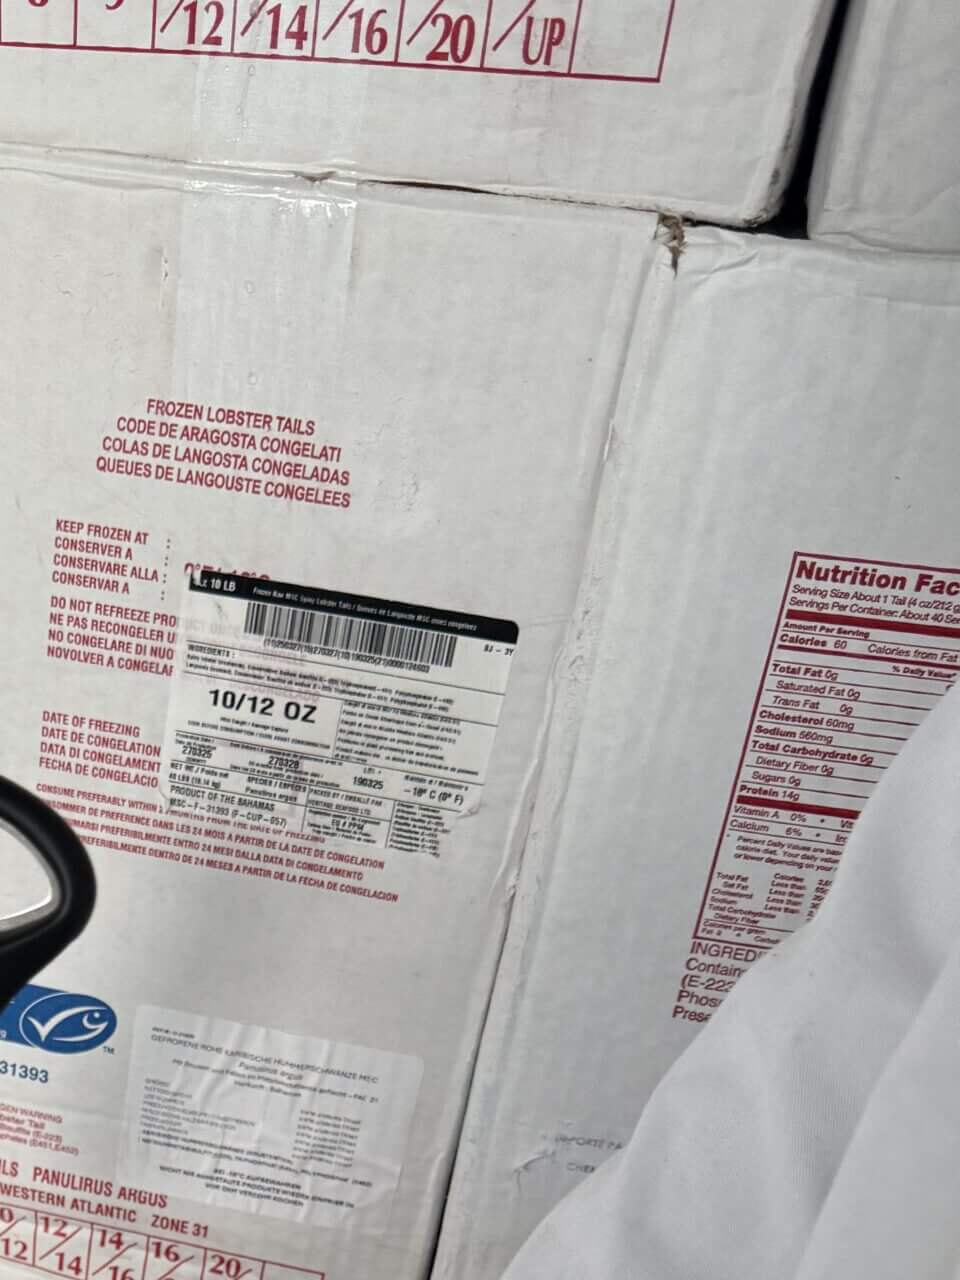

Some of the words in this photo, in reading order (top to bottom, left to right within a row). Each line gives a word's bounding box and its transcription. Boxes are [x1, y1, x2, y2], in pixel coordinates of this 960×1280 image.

[147, 399, 204, 420] FROZEN
[207, 407, 271, 429] LOBSTER
[277, 416, 315, 436] TAILS
[117, 417, 156, 435] CODE
[159, 422, 177, 437] DE
[181, 426, 257, 450] ARAGOSTA
[260, 437, 341, 462] CONGELATI
[102, 436, 149, 456] COLAS
[152, 442, 171, 459] DE
[175, 446, 247, 470] LANGOSTA
[251, 457, 349, 486] CONGELADAS
[96, 457, 152, 478] QUEUES
[155, 465, 174, 481] DE
[176, 469, 261, 494] LANGOUSTE
[264, 482, 350, 508] CONGELEES
[56, 519, 84, 534] KEEP
[88, 524, 131, 543] FROZEN
[135, 532, 149, 545] AT
[55, 536, 122, 558] CONSERVER
[125, 548, 133, 561] A
[52, 571, 118, 592] CONSERVAR
[122, 582, 130, 595] A
[53, 554, 127, 576] CONSERVARE
[130, 566, 159, 582] ALLA
[796, 560, 907, 591] Nutrition
[915, 573, 960, 596] Fac
[223, 580, 236, 592] LB
[50, 596, 66, 610] DO
[69, 599, 92, 614] NOT
[95, 604, 150, 624] REFREEZE
[153, 614, 176, 628] PRO
[50, 613, 64, 626] NE
[67, 616, 88, 630] PAS
[90, 620, 164, 643] RECONGELER
[780, 634, 827, 647] Calories
[47, 646, 105, 666] NOVOLVER
[107, 656, 115, 667] A
[48, 629, 64, 643] NO
[66, 633, 133, 654] CONGELARE
[136, 643, 147, 656] DI
[150, 646, 174, 660] NUO
[209, 688, 274, 716] 10/12
[283, 701, 317, 724] OZ
[42, 711, 69, 727] DATE
[72, 716, 87, 730] OF
[89, 718, 140, 738] FREEZING
[41, 726, 68, 742] DATE
[70, 731, 85, 745] DE
[87, 733, 160, 757] CONGELATION
[40, 742, 67, 758] DATA
[69, 747, 79, 760] DI
[82, 748, 160, 773] CONGELAMENT
[39, 758, 72, 774] FECHA
[75, 762, 89, 777] DE
[92, 765, 158, 788] CONGELACIO
[353, 776, 384, 790] 190325
[36, 783, 75, 797] CONSUME
[77, 790, 126, 807] PREFERABLY
[128, 800, 158, 812] WITHIN
[170, 785, 206, 798] PRODUCT
[208, 790, 218, 800] OF
[221, 794, 235, 803] THE
[239, 797, 275, 811] BAHAMAS
[148, 847, 181, 862] DENTRO
[182, 854, 192, 864] DE
[195, 856, 204, 866] 24
[206, 857, 234, 872] MESES
[234, 863, 240, 873] A
[242, 864, 272, 878] PARTIR
[273, 870, 284, 881] DE
[286, 872, 297, 883] LA
[299, 874, 325, 889] FECHA
[327, 880, 337, 891] DE
[339, 882, 399, 902] CONGELACION
[33, 1167, 113, 1197] PANULIRUS
[117, 1186, 168, 1208] ARGUS
[70, 1197, 137, 1223] ATLANTIC
[152, 1214, 190, 1235] ZONE
[192, 1224, 209, 1238] 31
